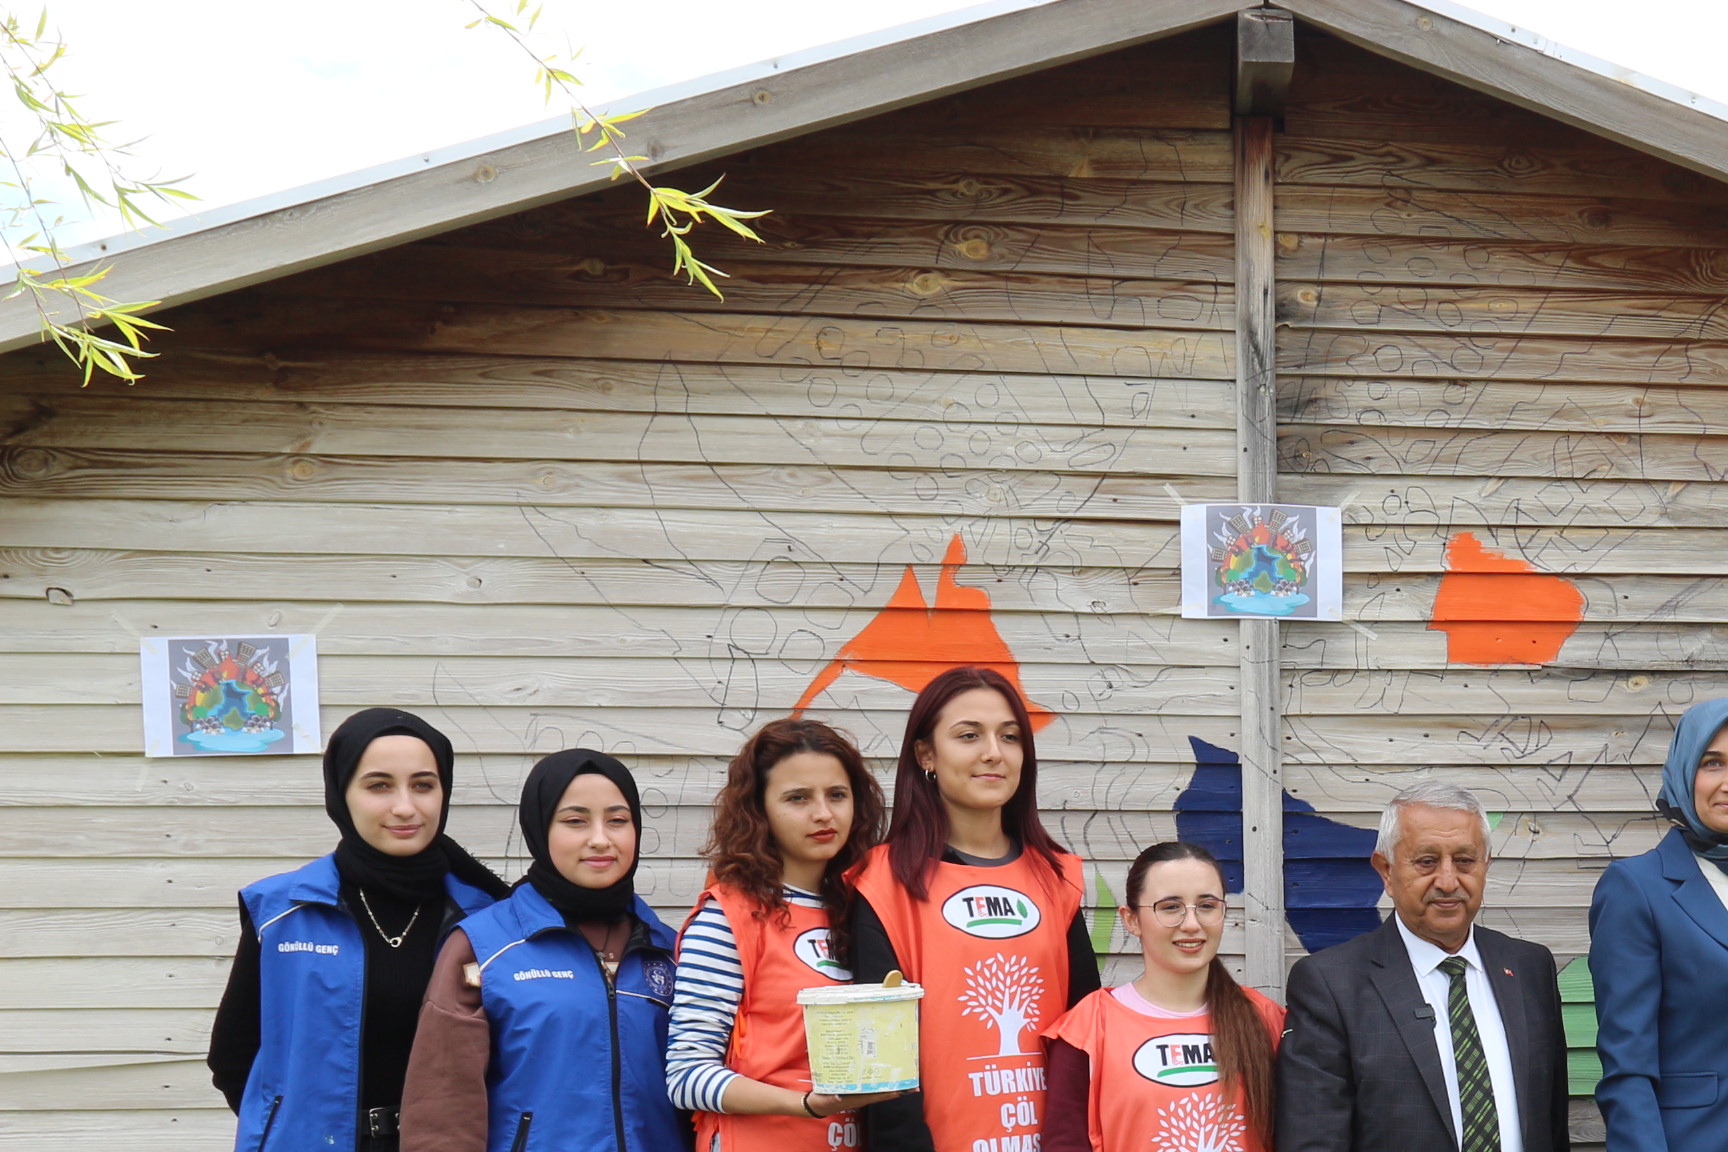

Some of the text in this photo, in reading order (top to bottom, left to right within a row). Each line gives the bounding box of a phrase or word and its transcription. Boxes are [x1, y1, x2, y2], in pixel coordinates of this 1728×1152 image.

[962, 896, 1016, 918] TEMA
[278, 940, 339, 956] GÖNÜLLÜ GENÇ
[513, 968, 575, 981] GÖNÜLLÜ GENÇ
[1156, 1044, 1215, 1067] TEMA
[968, 1062, 1048, 1097] TÜRKİYE
[1000, 1096, 1039, 1132] ÇÖL
